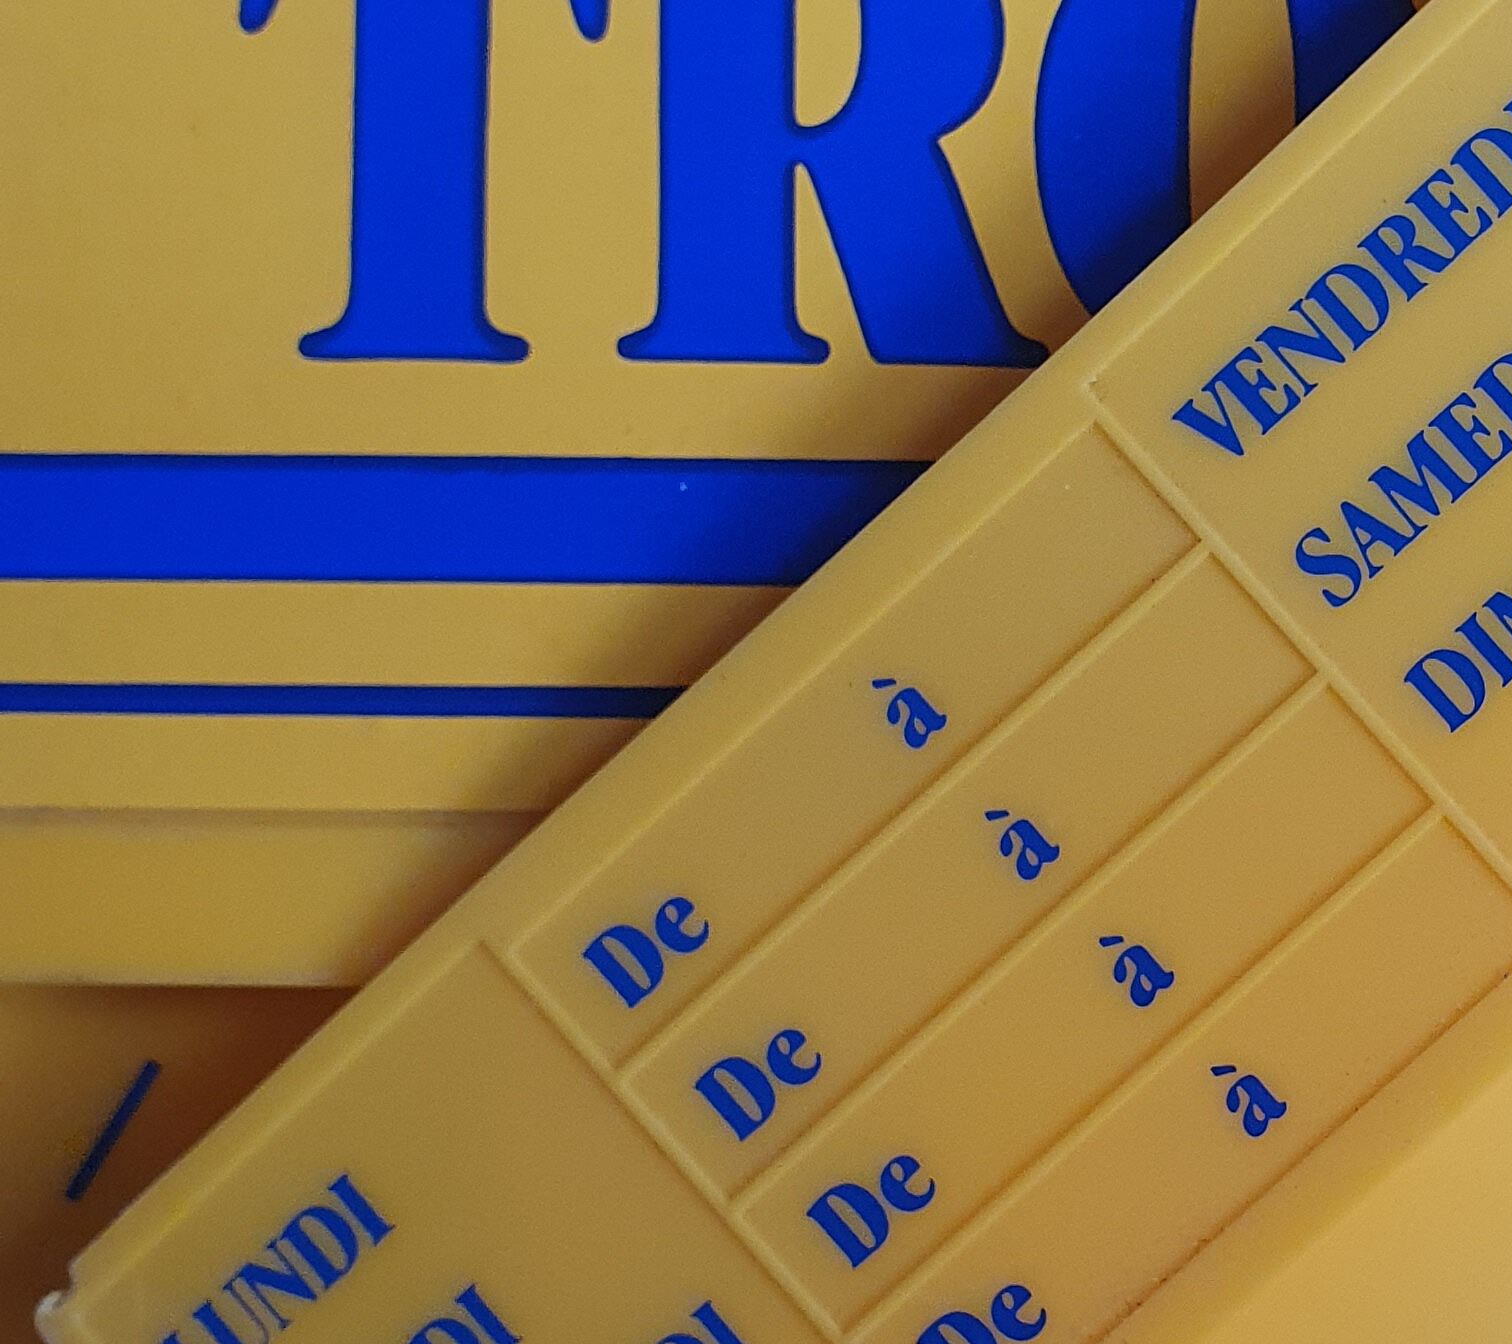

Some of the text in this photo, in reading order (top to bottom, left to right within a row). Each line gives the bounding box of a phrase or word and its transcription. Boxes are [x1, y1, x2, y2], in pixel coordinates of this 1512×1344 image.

[581, 896, 709, 1009] De
[870, 678, 948, 750] à
[693, 1028, 822, 1142] De
[984, 809, 1060, 882] à
[805, 1155, 935, 1269] De
[1098, 935, 1175, 1008] à
[1210, 1065, 1287, 1138] à
